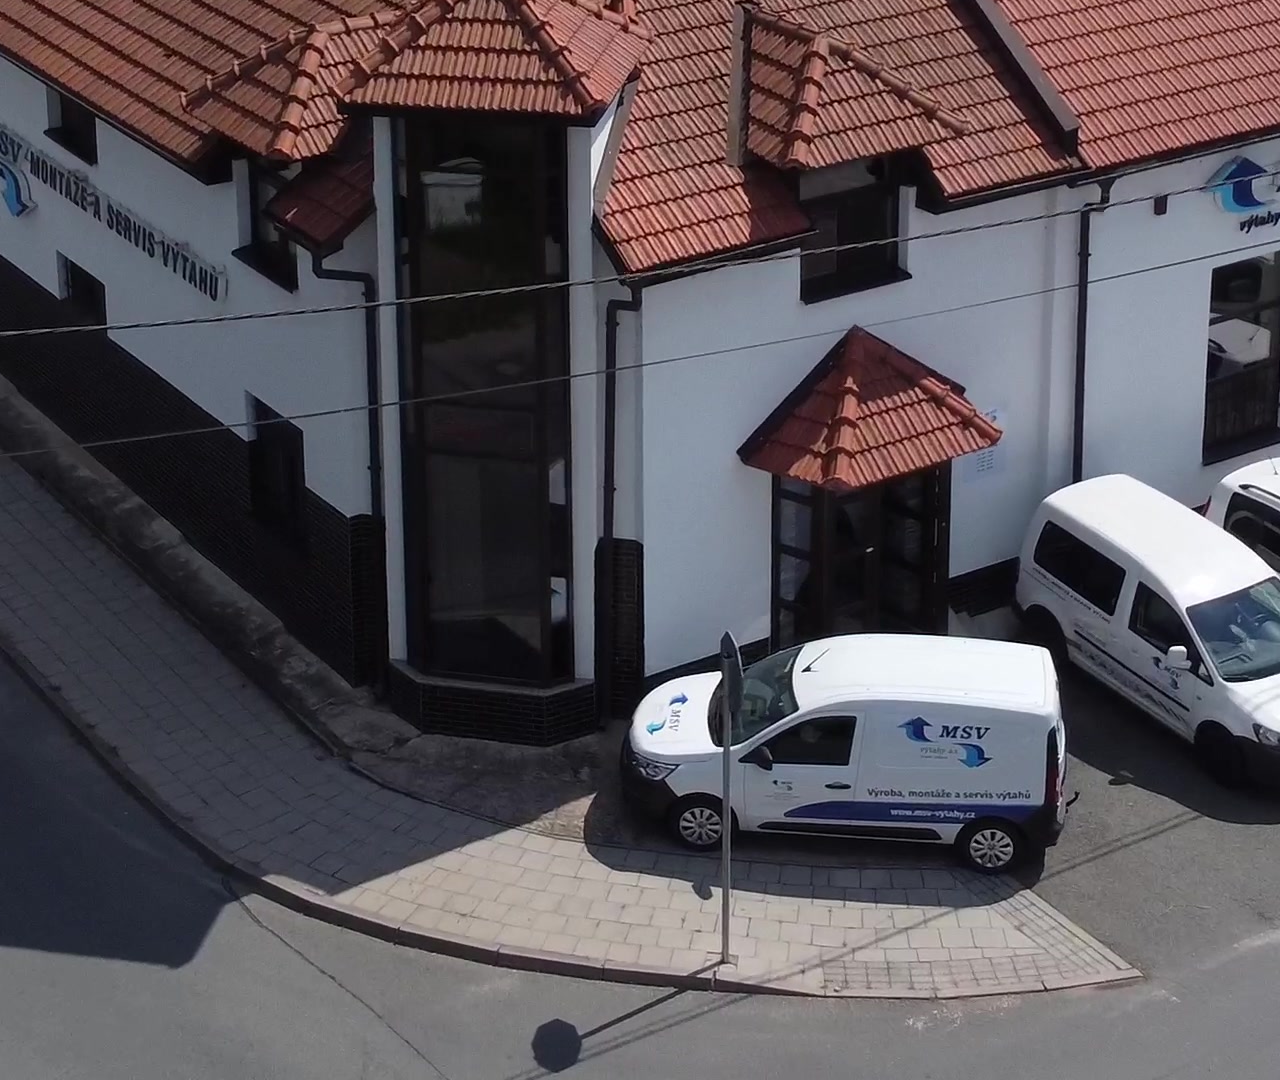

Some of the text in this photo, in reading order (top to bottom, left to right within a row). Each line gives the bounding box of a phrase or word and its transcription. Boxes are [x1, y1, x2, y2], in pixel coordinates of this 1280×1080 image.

[30, 150, 88, 213] MONTÁŽE
[92, 194, 102, 222] A
[106, 202, 156, 258] SERVIS
[161, 240, 219, 302] VÝTAHŮ
[668, 709, 682, 731] MSV
[938, 725, 991, 740] MSV
[867, 787, 1032, 801] Výroba, montáže a servis výtahů
